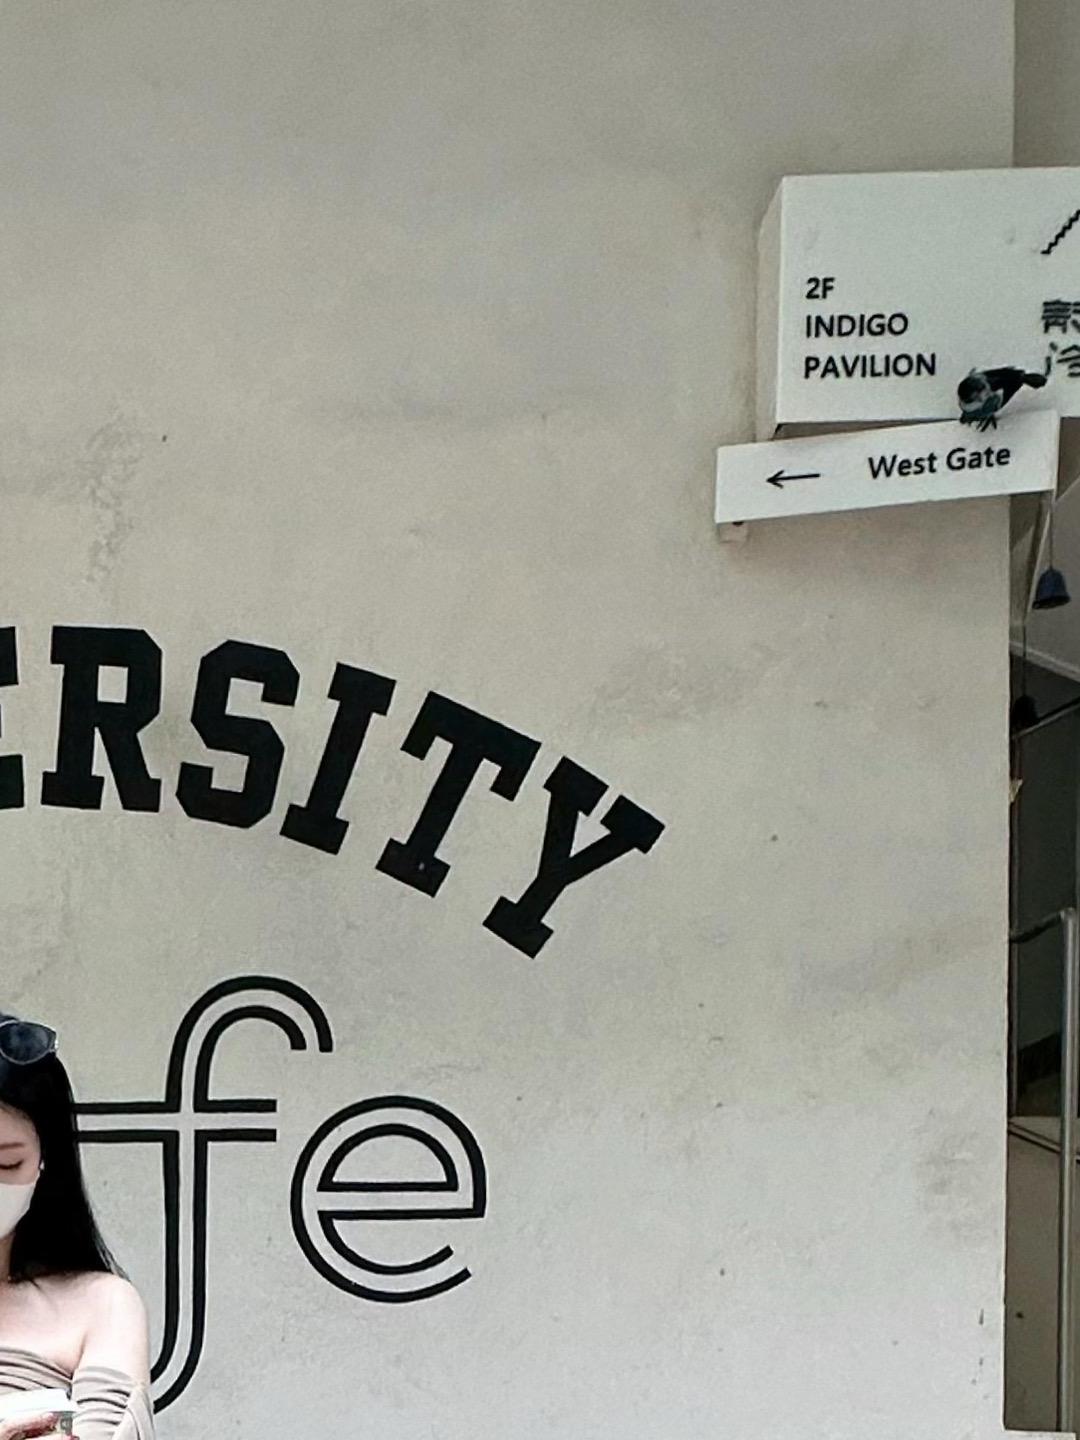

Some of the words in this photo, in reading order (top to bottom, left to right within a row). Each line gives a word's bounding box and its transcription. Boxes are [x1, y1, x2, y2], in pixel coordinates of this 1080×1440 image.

[804, 276, 836, 300] 2F
[805, 312, 909, 339] INDIGO
[803, 352, 937, 380] PAVILION
[867, 452, 938, 480] West
[945, 446, 1011, 472] Gate
